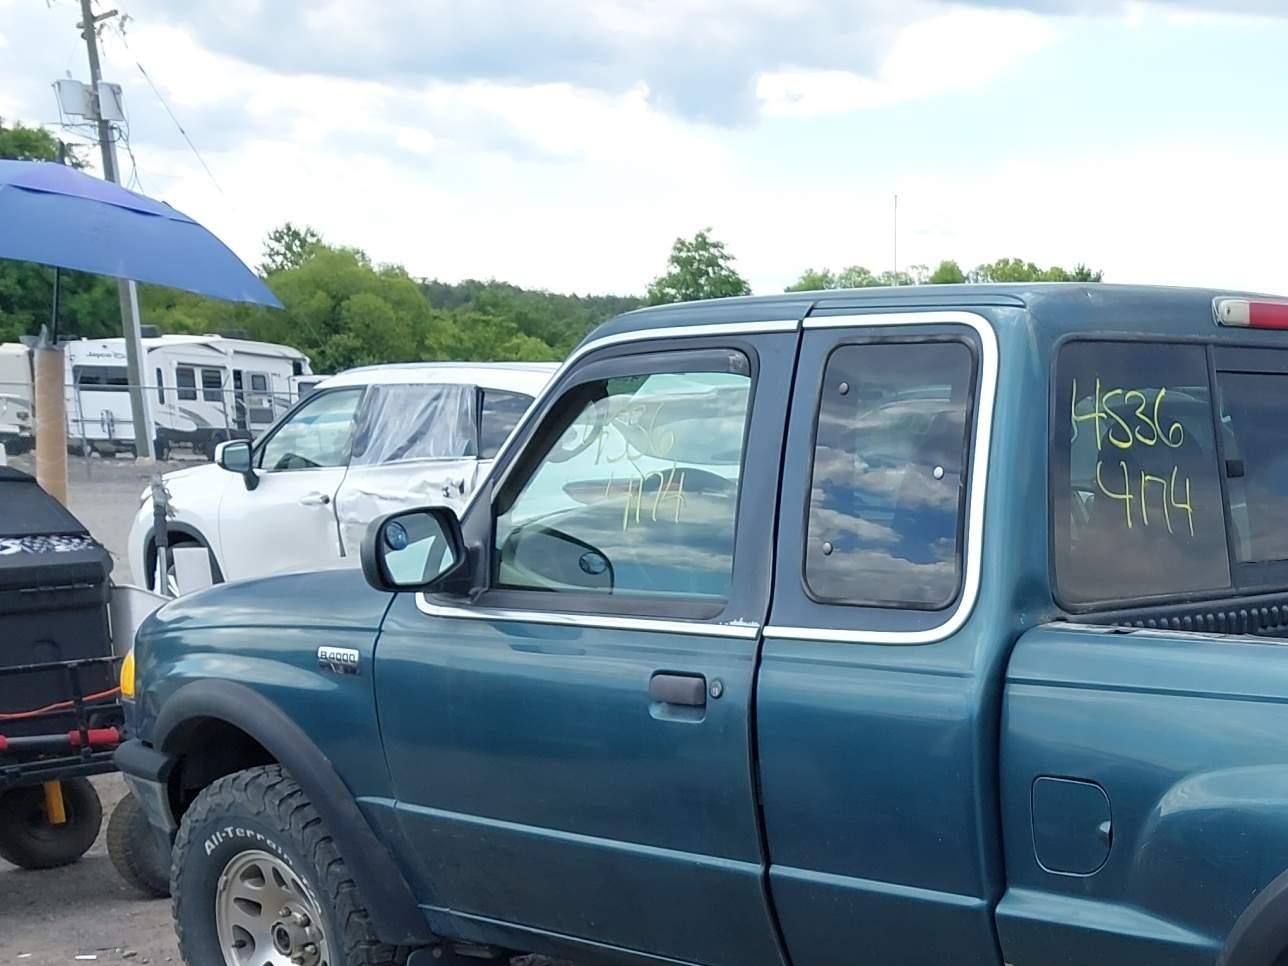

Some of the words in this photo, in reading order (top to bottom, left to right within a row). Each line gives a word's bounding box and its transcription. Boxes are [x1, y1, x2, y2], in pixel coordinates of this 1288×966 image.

[1071, 377, 1184, 451] 4536
[1096, 460, 1195, 537] 4174
[320, 650, 357, 664] B4000
[204, 826, 293, 866] All-Terrain
